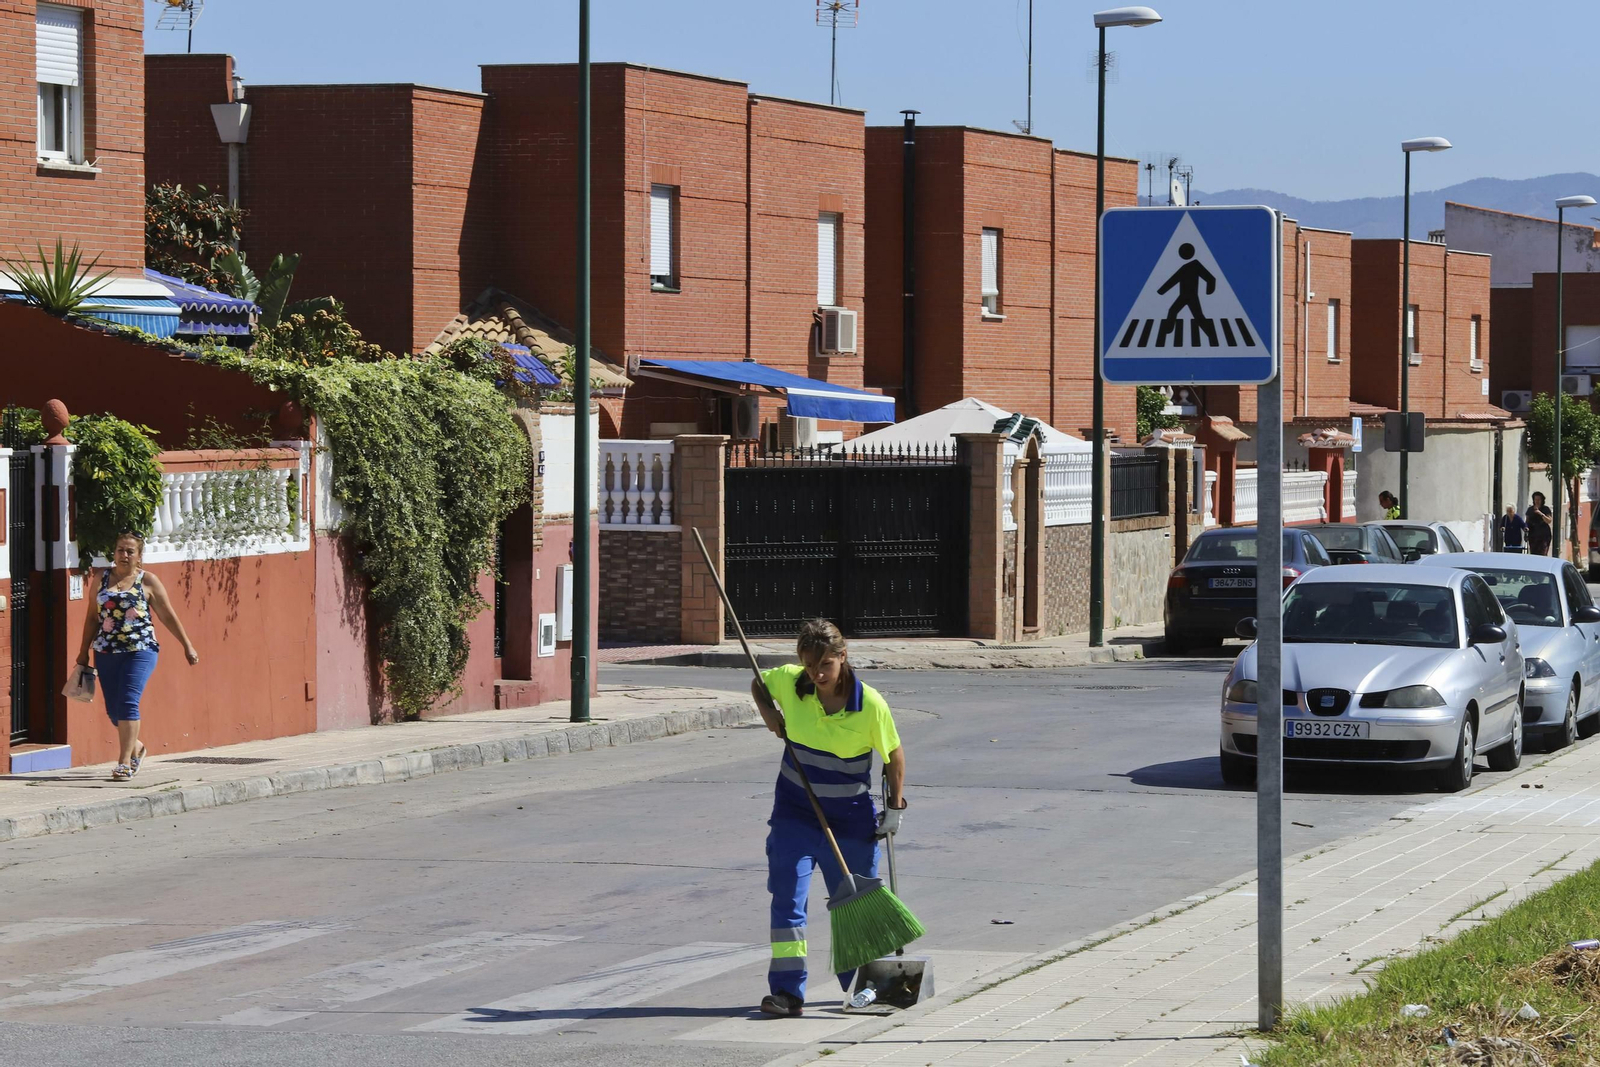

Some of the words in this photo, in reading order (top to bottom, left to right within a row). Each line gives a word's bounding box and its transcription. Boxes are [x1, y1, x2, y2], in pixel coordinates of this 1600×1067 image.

[1214, 579, 1235, 587] 3847
[1237, 579, 1253, 587] BNS
[1294, 722, 1331, 736] 9932
[1333, 723, 1361, 737] CZX
